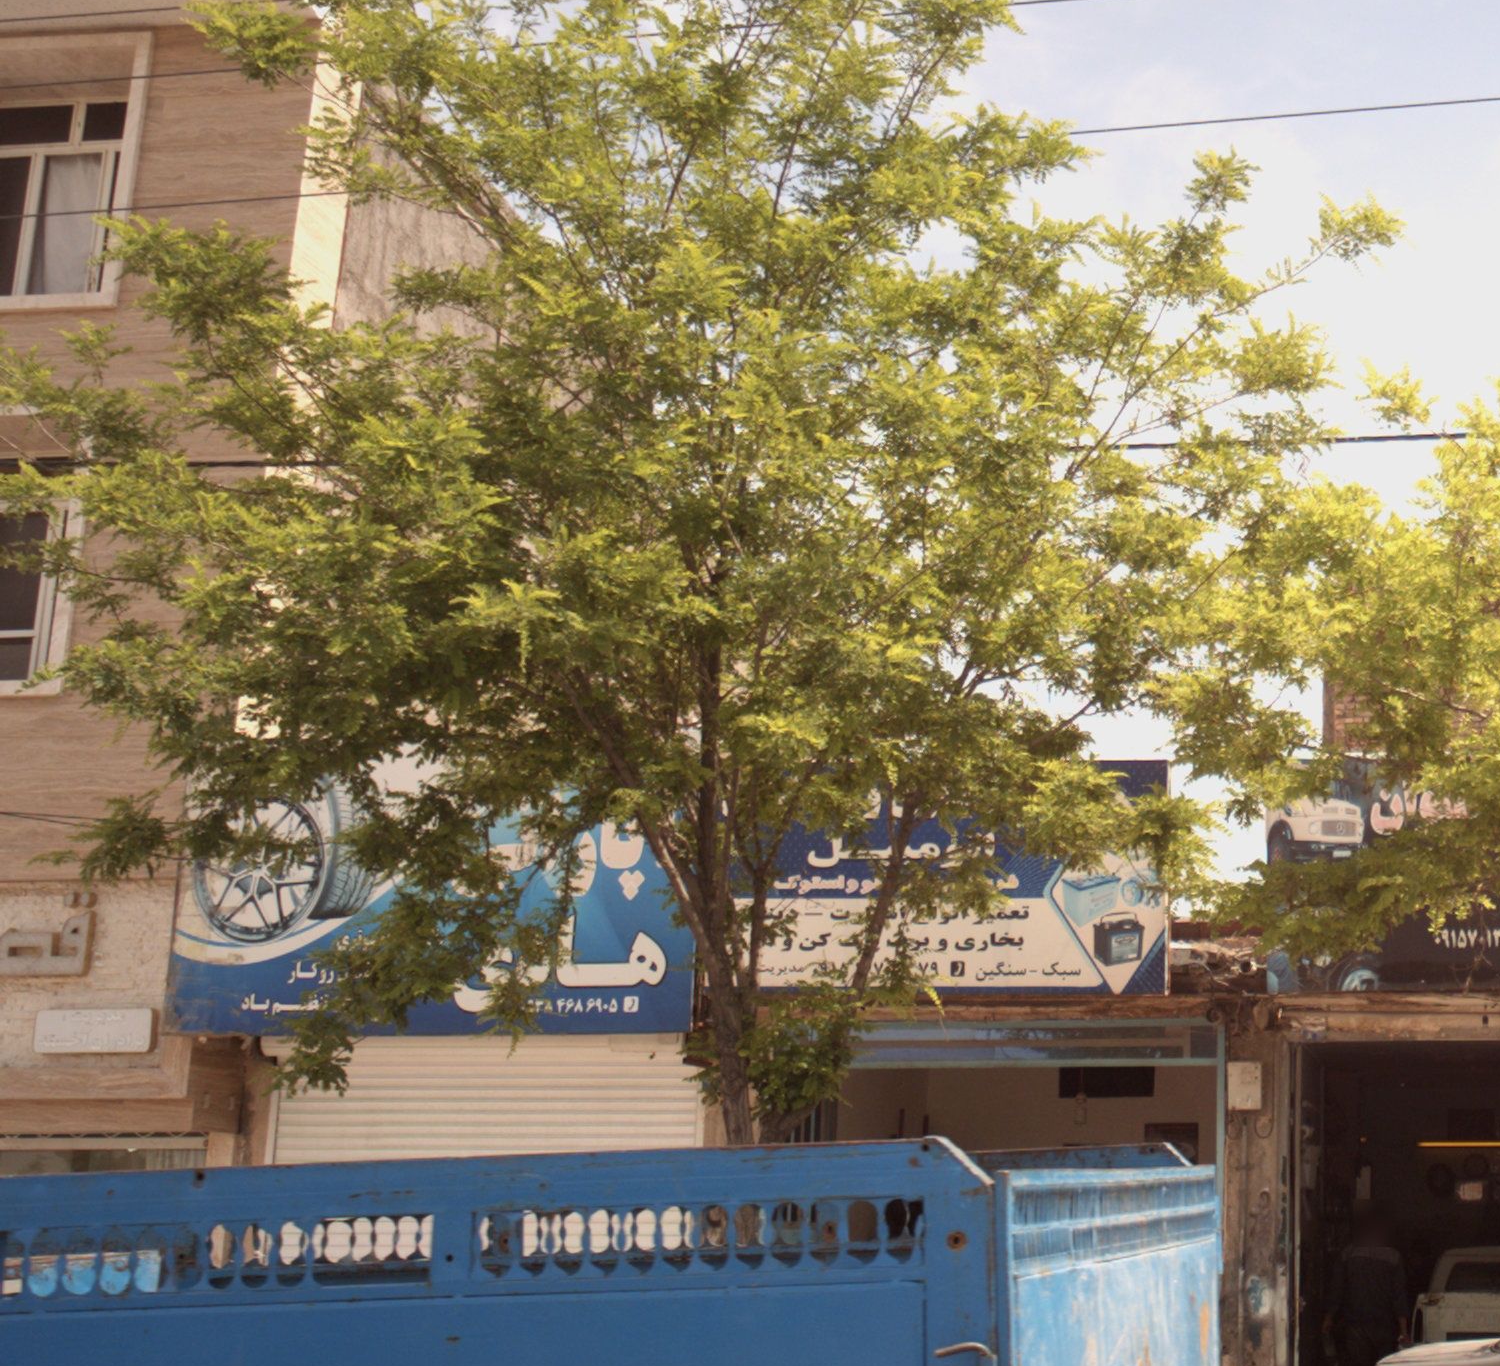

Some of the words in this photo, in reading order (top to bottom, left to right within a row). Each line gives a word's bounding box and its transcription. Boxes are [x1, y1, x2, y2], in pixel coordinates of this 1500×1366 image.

[954, 932, 1024, 951] بخاری
[975, 962, 1026, 981] سنگین
[1041, 961, 1081, 979] سبک
[240, 992, 271, 1016] باد
